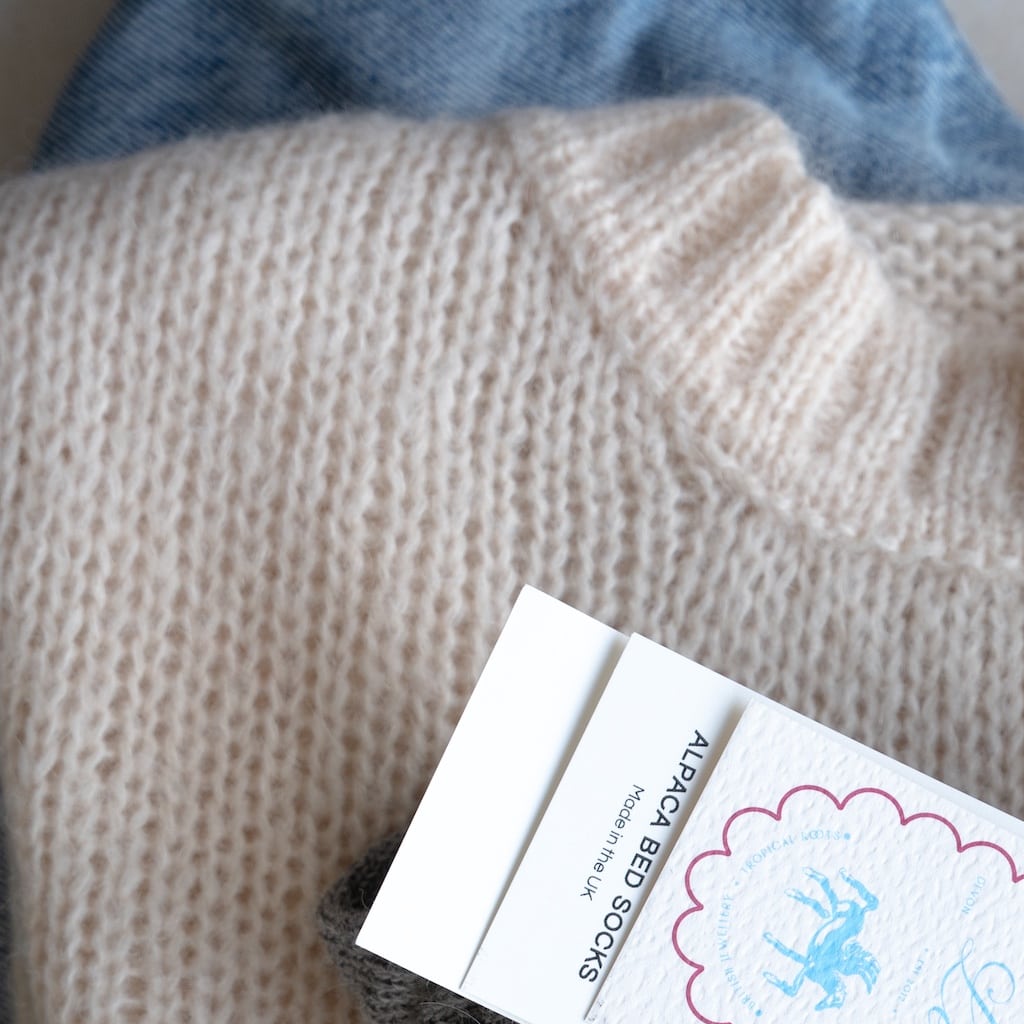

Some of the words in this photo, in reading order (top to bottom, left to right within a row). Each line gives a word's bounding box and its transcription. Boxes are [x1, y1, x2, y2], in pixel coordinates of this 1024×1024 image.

[650, 730, 709, 827] ALPACA
[614, 784, 645, 829] Made
[606, 830, 624, 845] in
[741, 834, 795, 873] TROPICAL
[593, 848, 615, 873] the
[624, 836, 661, 888] BED
[580, 875, 602, 901] UK
[961, 875, 987, 915] DEVON
[578, 895, 632, 982] SOCKS
